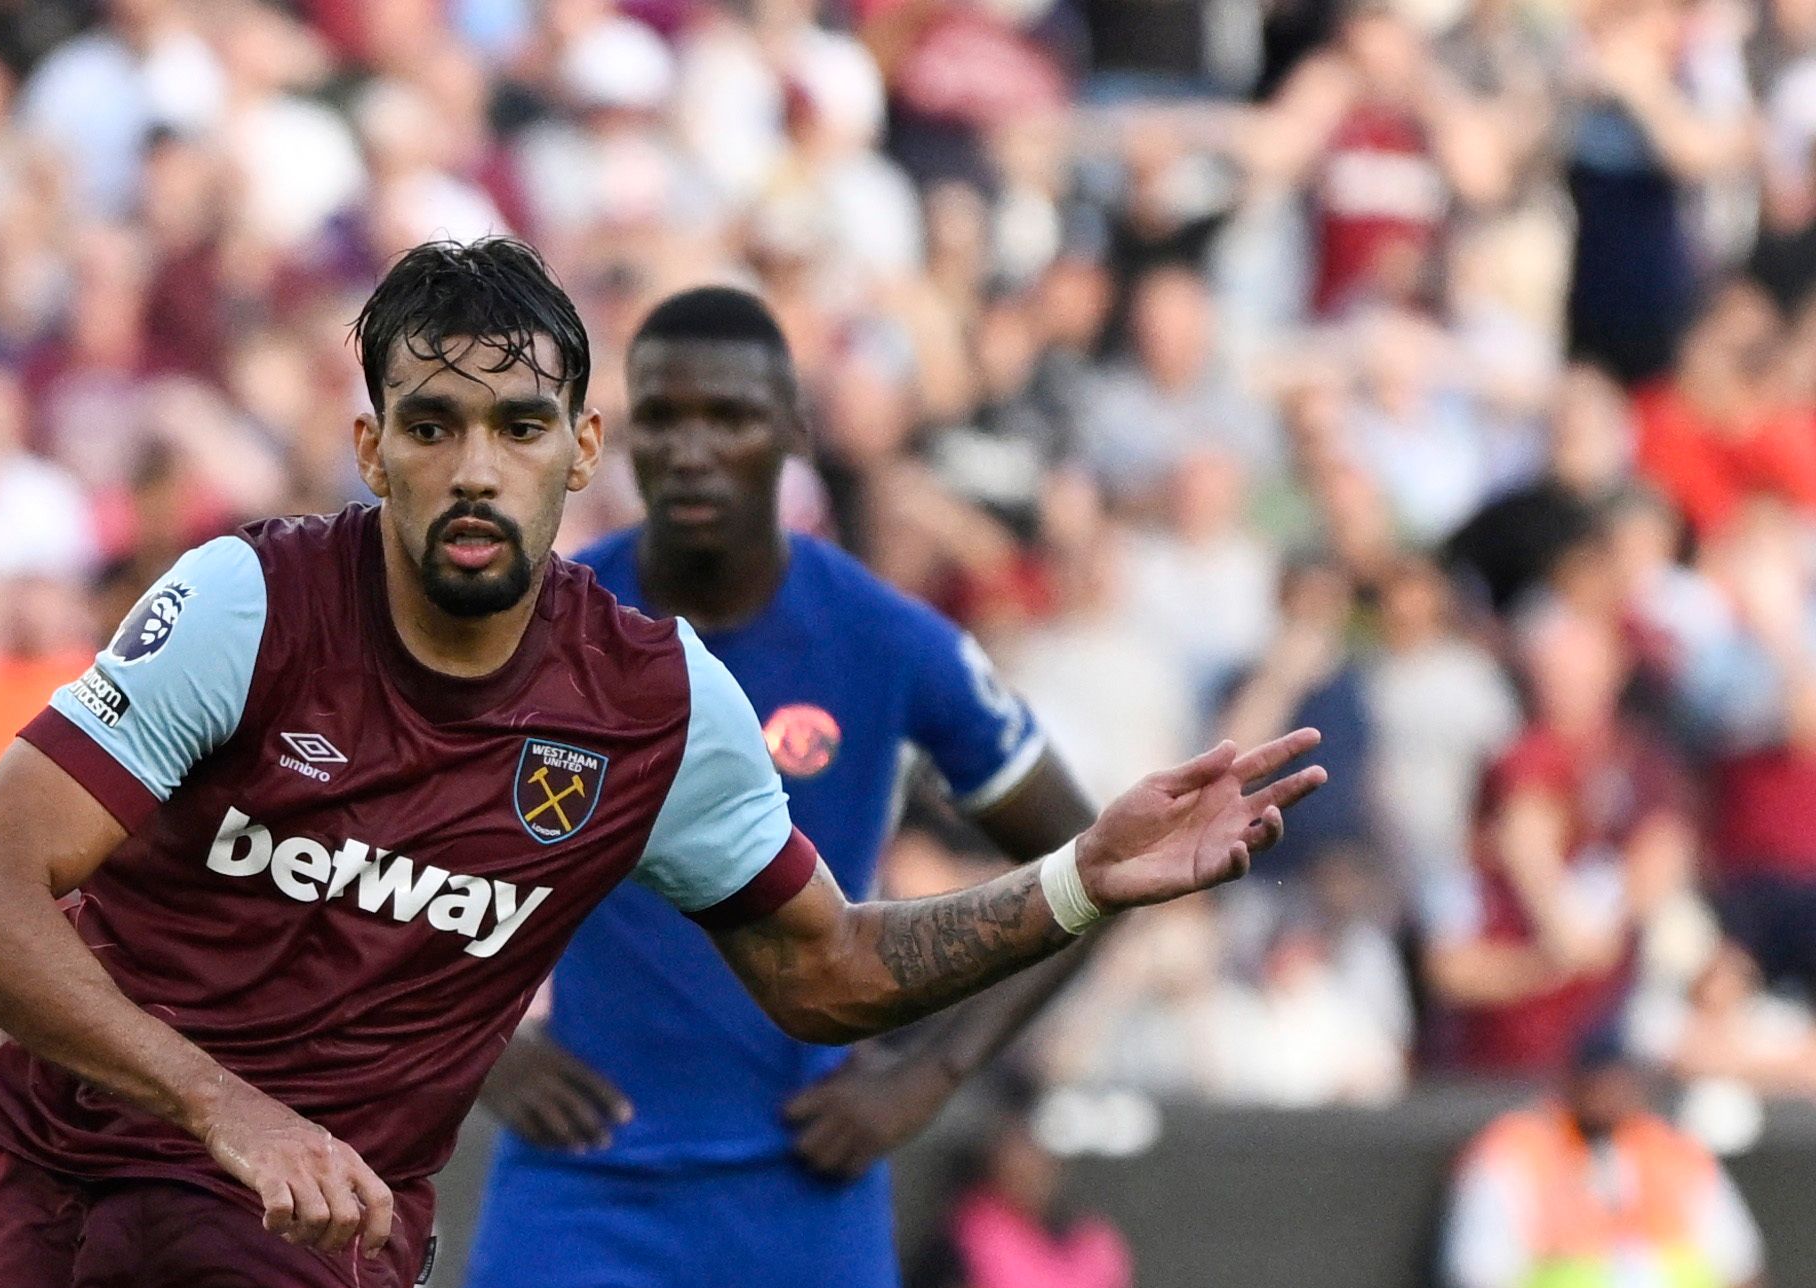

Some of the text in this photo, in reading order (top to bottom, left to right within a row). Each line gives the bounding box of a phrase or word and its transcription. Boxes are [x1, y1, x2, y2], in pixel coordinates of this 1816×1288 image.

[279, 754, 331, 782] umbro
[532, 744, 598, 770] WEST HAM
[543, 756, 583, 773] UNITED
[206, 805, 554, 958] betway
